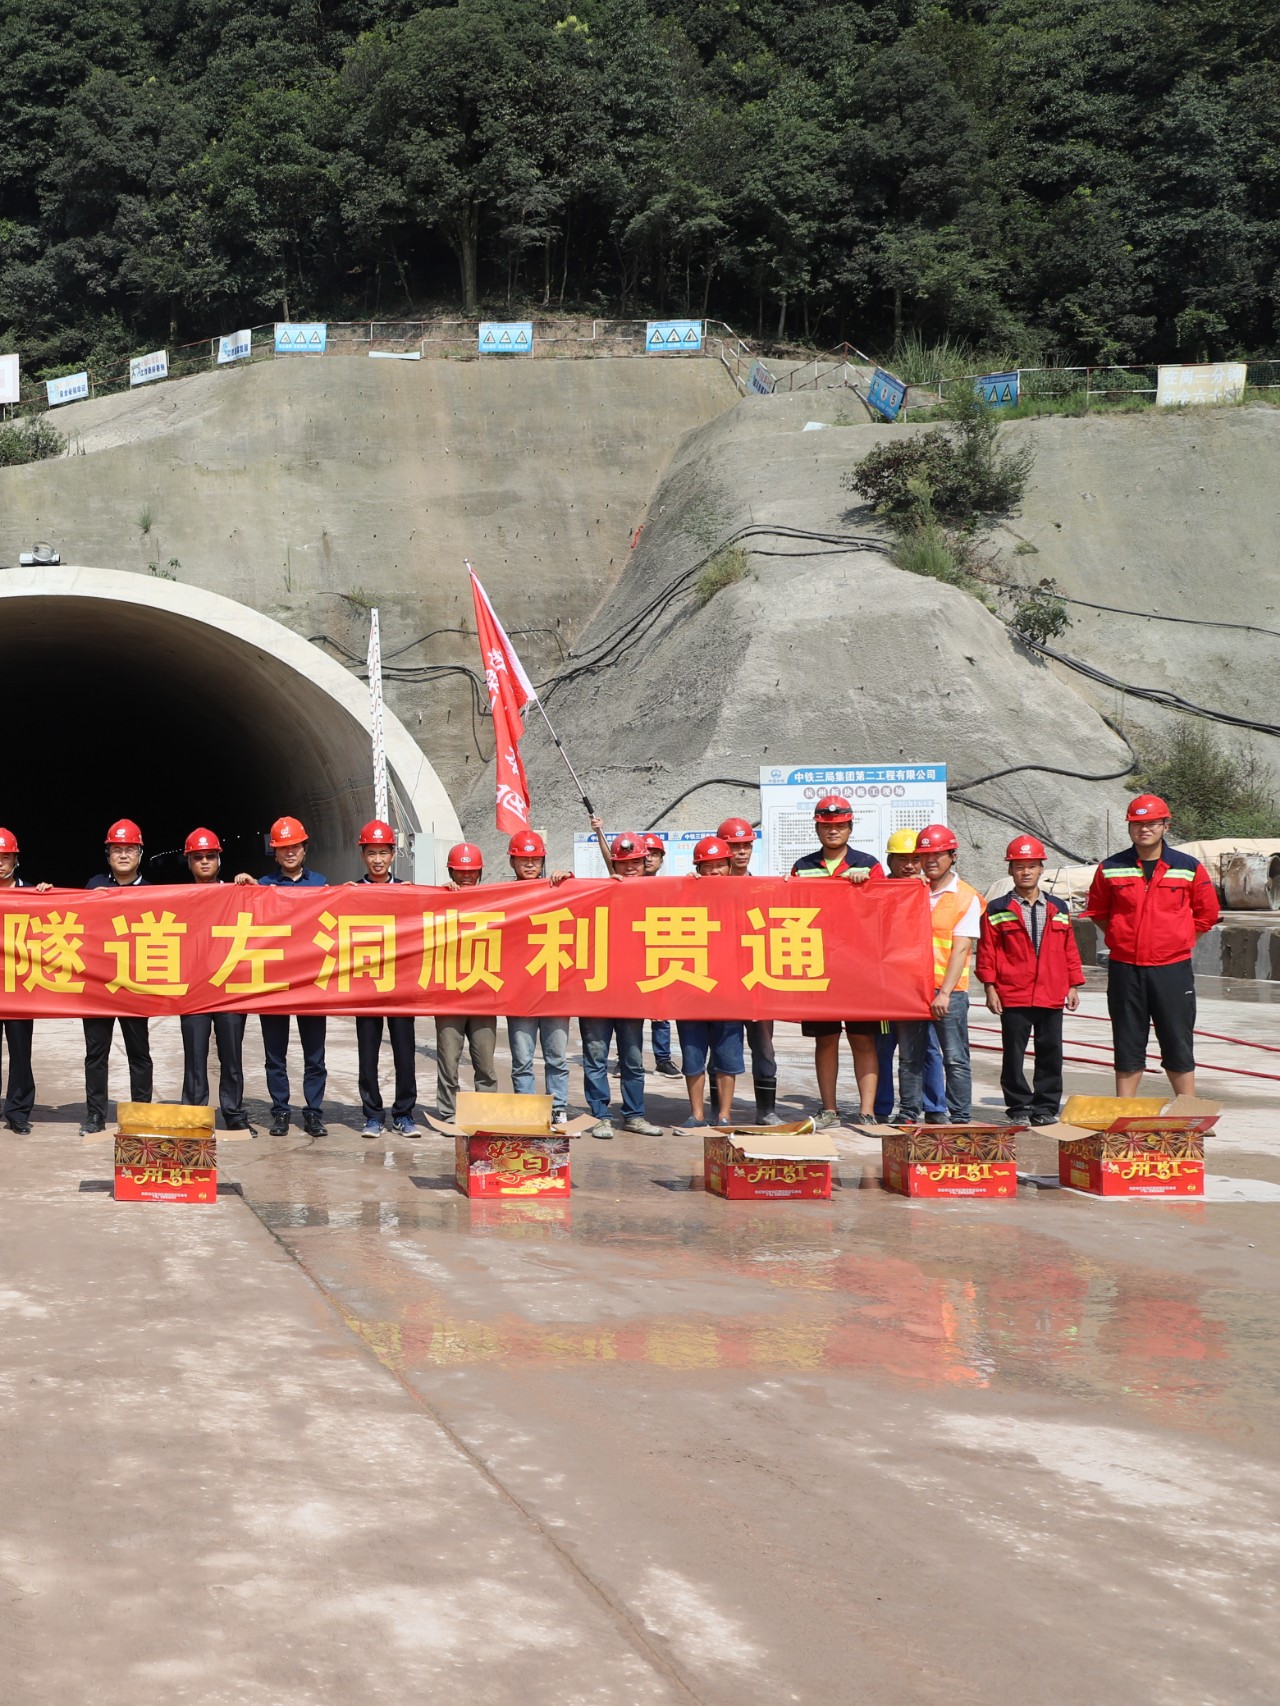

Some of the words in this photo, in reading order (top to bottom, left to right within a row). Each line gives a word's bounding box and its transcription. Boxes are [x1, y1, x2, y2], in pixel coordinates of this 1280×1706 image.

[1164, 366, 1242, 385] 在岗一分钟
[794, 769, 936, 783] 中铁三局集团第二工程有限公司
